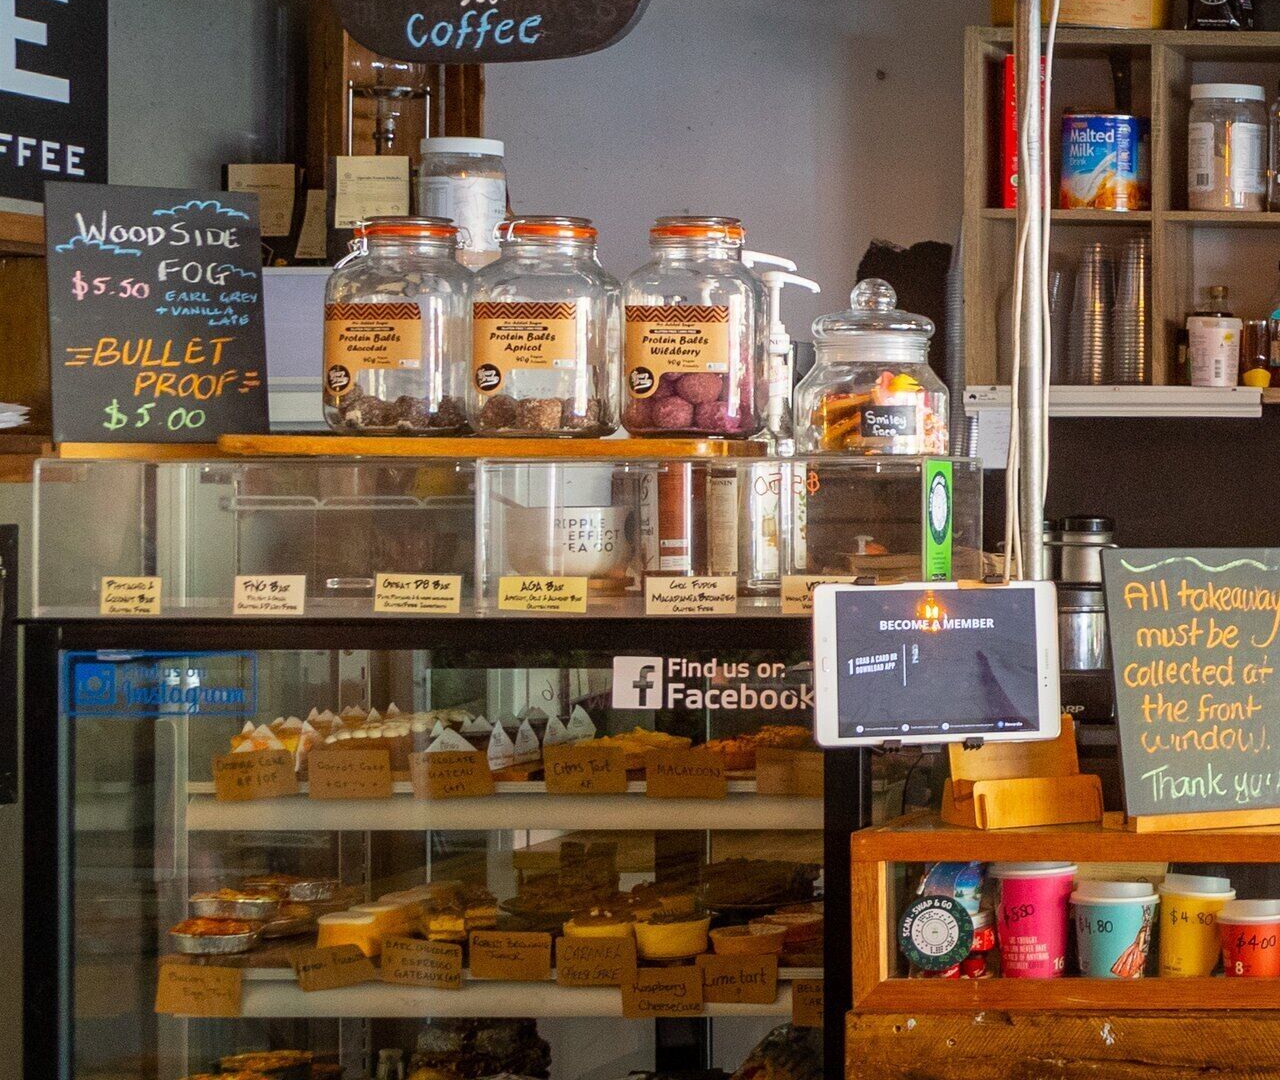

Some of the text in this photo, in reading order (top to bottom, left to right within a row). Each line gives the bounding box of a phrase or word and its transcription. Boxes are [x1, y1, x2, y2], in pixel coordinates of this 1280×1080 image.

[407, 8, 542, 49] Coffee
[1070, 129, 1115, 142] Malted
[1070, 143, 1095, 157] Milk
[158, 259, 230, 285] FOG
[71, 270, 150, 300] $5.50
[166, 290, 258, 303] EARL GREY
[490, 333, 556, 341] Protein Balls
[642, 336, 709, 345] Protein Balls
[94, 337, 233, 366] BULLET
[505, 343, 541, 353] Apricot
[650, 347, 700, 356] Wildberry
[134, 370, 238, 398] PROOF
[865, 411, 906, 430] Smiley
[873, 424, 897, 438] face
[1124, 579, 1169, 611] All
[879, 620, 929, 631] BECOME
[943, 618, 995, 629] MEMBER
[1136, 618, 1240, 648] must be
[668, 658, 717, 678] Find
[723, 662, 748, 679] us
[1124, 655, 1274, 688] collected at
[668, 683, 815, 710] Facebook
[1142, 693, 1262, 723] the front
[1053, 956, 1065, 970] 16
[1235, 961, 1244, 975] 8
[740, 968, 768, 984] tart
